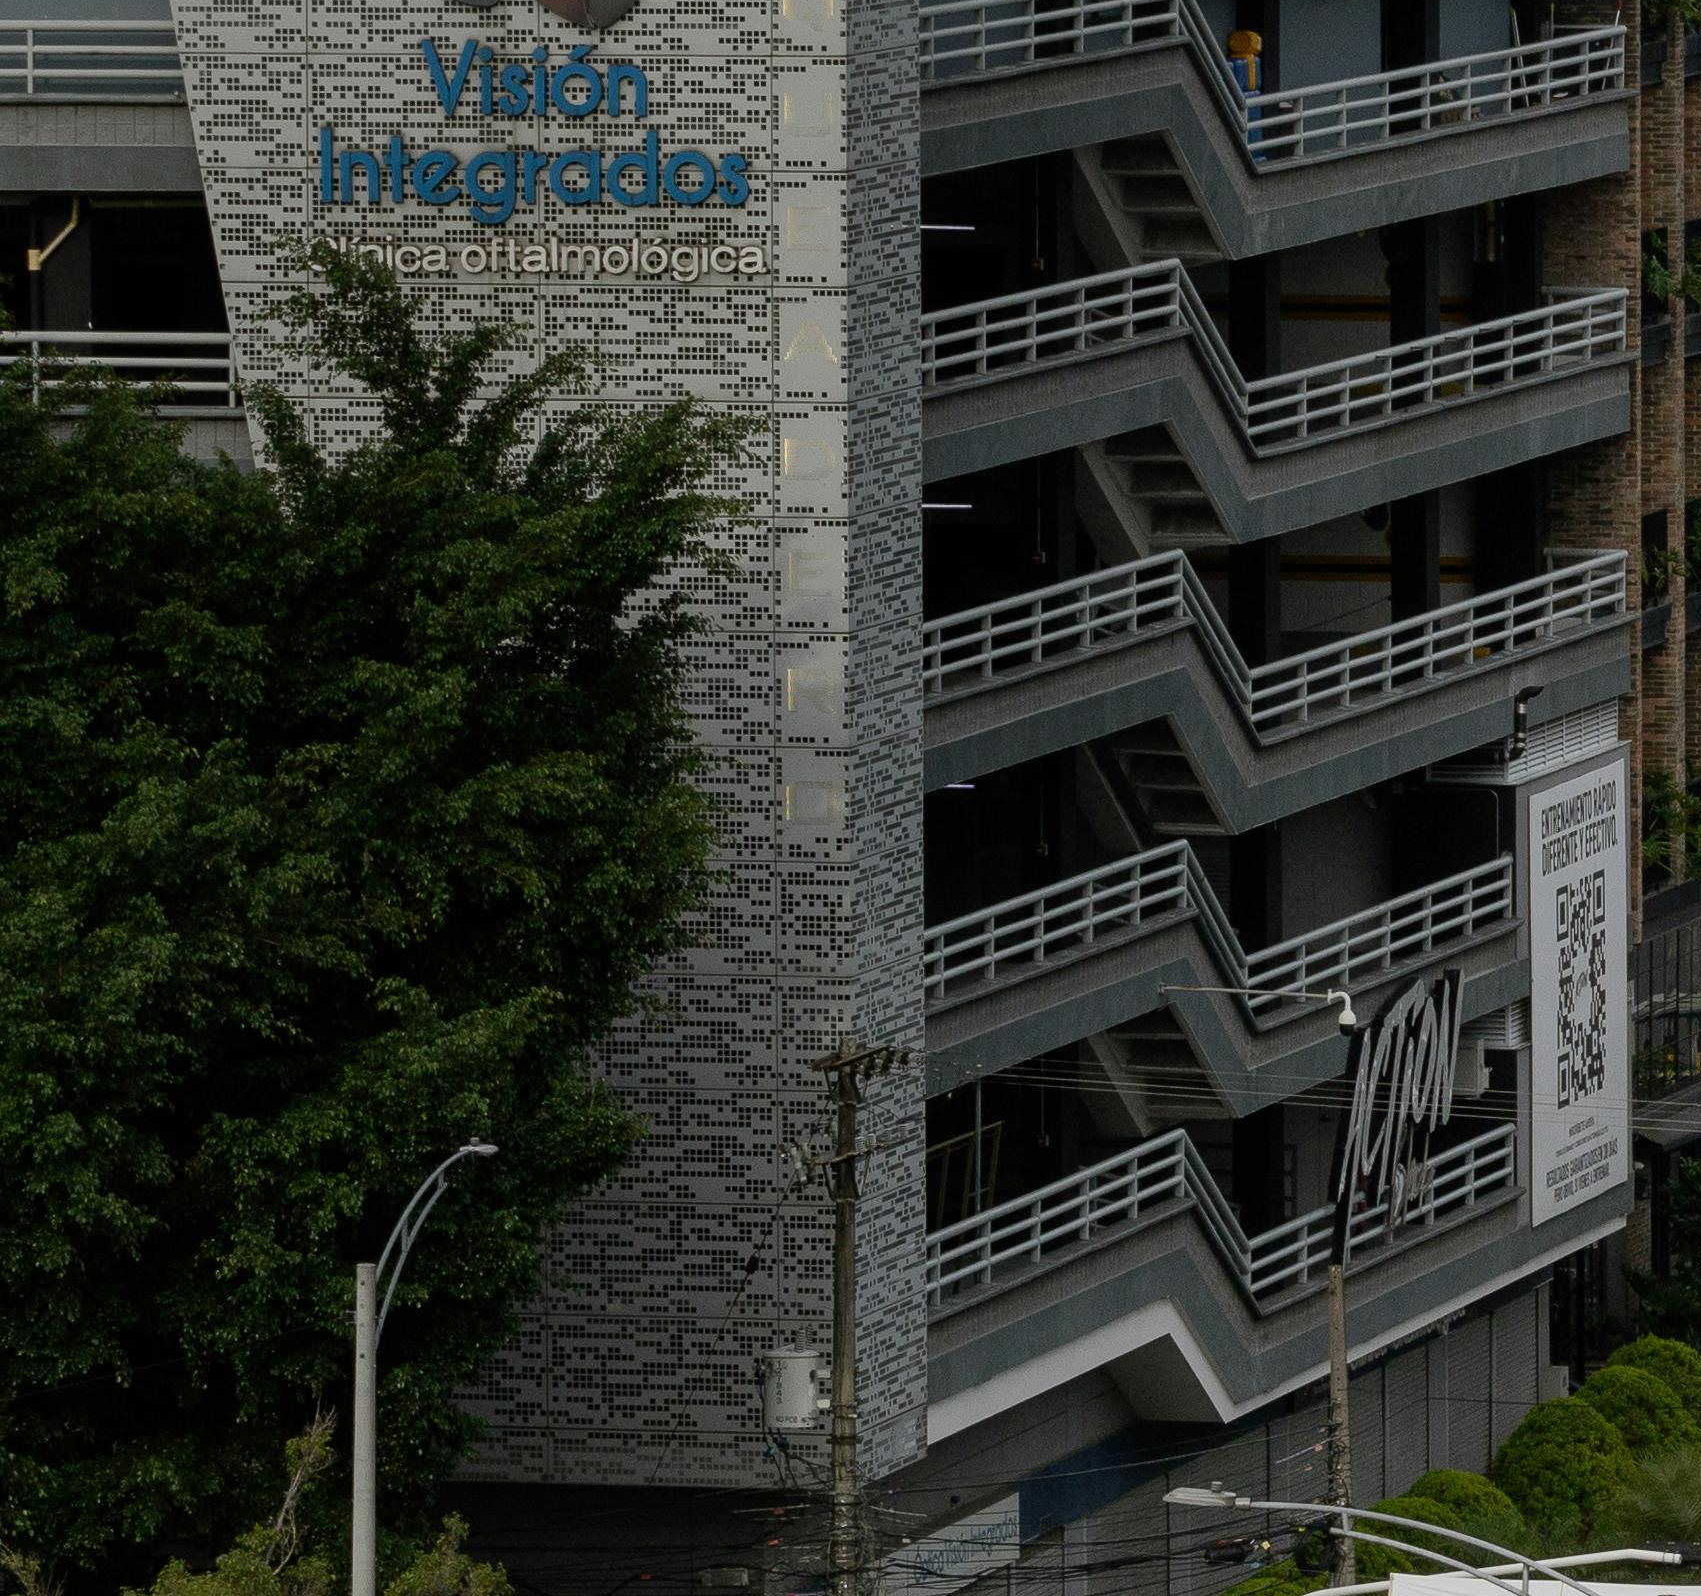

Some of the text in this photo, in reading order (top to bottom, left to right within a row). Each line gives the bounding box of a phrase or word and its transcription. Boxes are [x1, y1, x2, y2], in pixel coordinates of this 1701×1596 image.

[420, 38, 648, 120] Visión
[319, 124, 750, 226] Integrados
[460, 237, 767, 283] oftalmológica
[1542, 778, 1617, 840] ENTRENAMIENTO RÁPIDO
[1542, 830, 1578, 877] DIFERENTE
